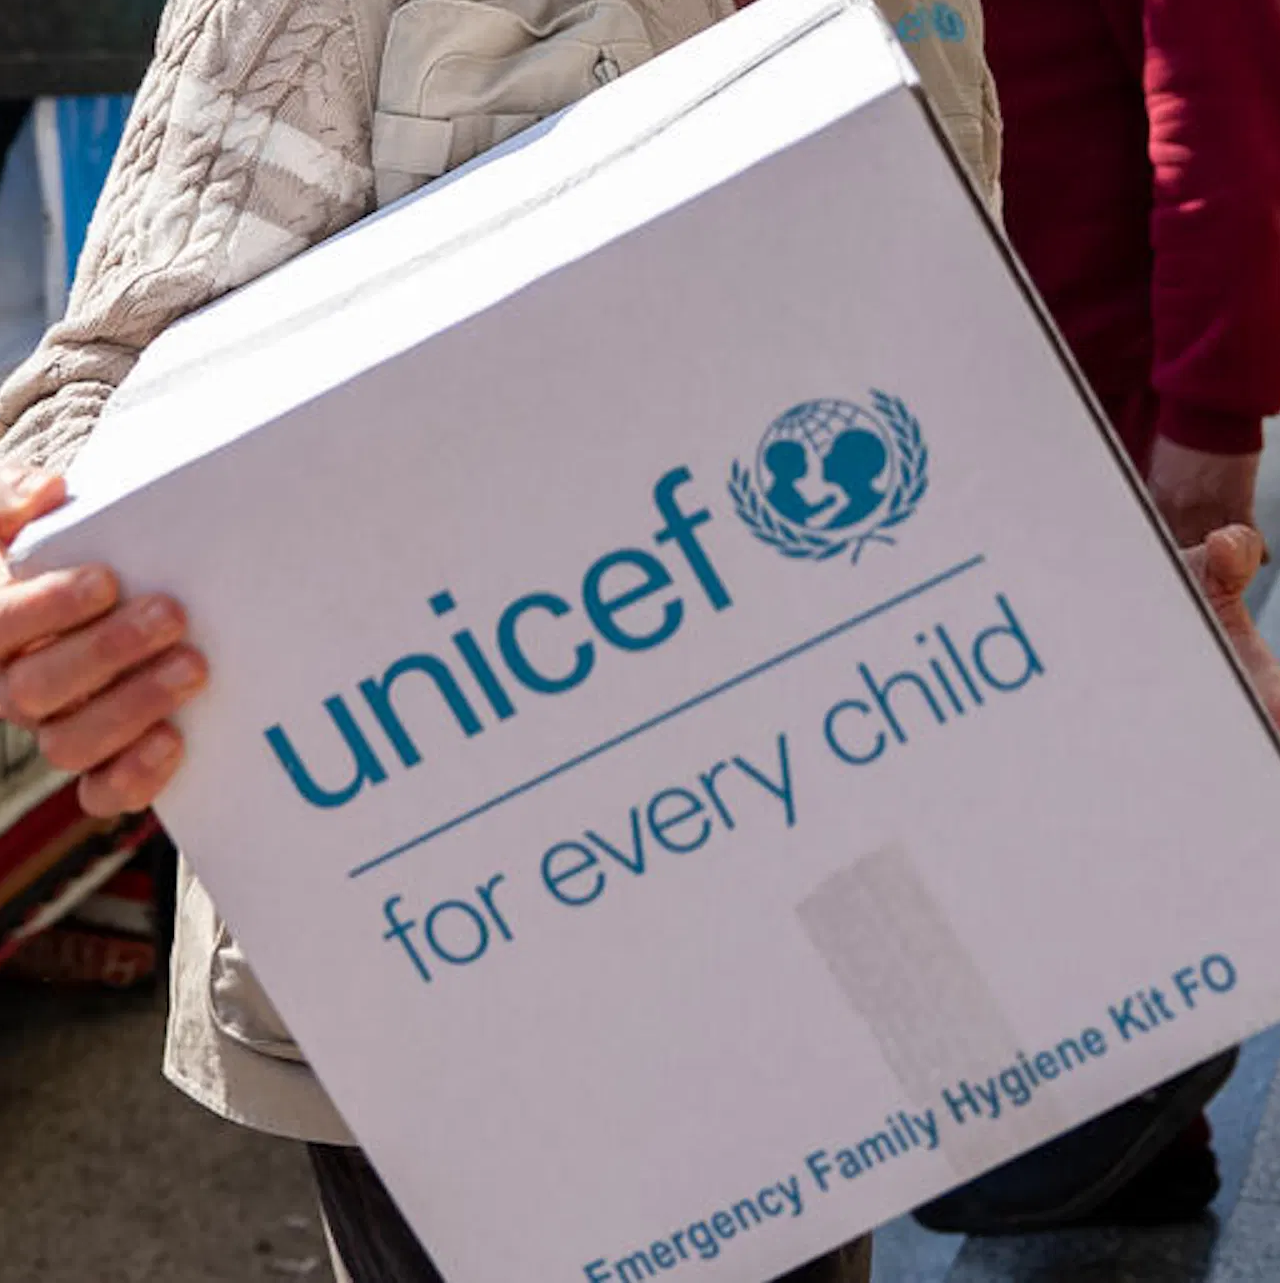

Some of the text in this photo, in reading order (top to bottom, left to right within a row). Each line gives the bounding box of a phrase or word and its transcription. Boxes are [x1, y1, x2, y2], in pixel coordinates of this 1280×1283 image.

[263, 466, 734, 810] unicef
[381, 594, 1046, 983] for every child
[806, 1110, 940, 1192] Family
[942, 1028, 1108, 1125] Hygiene
[1108, 990, 1175, 1042] Kit
[1173, 954, 1238, 1011] FO
